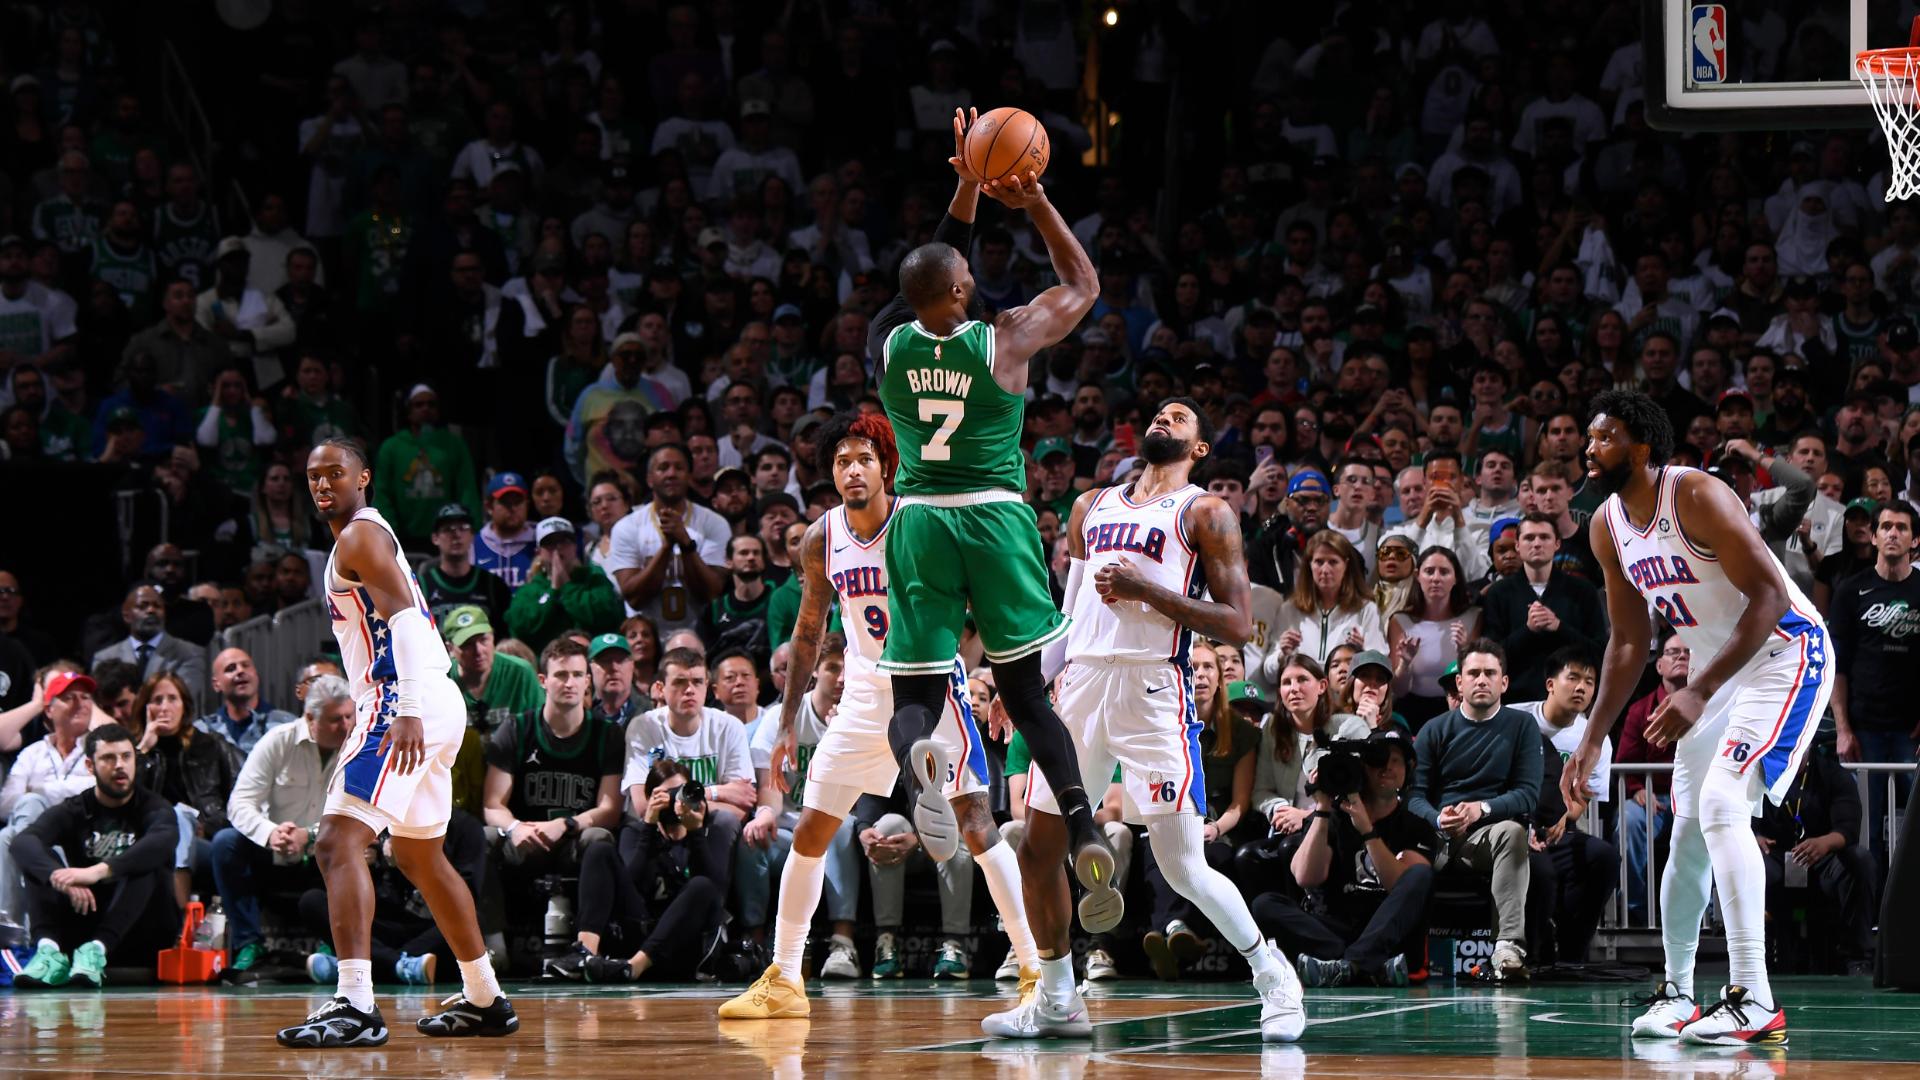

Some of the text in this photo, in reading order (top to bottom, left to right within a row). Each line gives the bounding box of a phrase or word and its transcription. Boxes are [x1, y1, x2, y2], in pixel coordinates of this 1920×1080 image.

[1697, 66, 1713, 80] NBA
[907, 368, 973, 399] BROWN
[918, 398, 965, 461] 7
[1087, 523, 1166, 564] PHILA
[832, 567, 888, 601] PHIL
[1628, 556, 1701, 595] PHILA
[662, 586, 685, 621] 0
[1655, 592, 1698, 627] 21
[864, 605, 889, 640] 9
[1721, 738, 1751, 762] 76
[525, 771, 597, 808] CELTICS
[1149, 781, 1177, 803] 76
